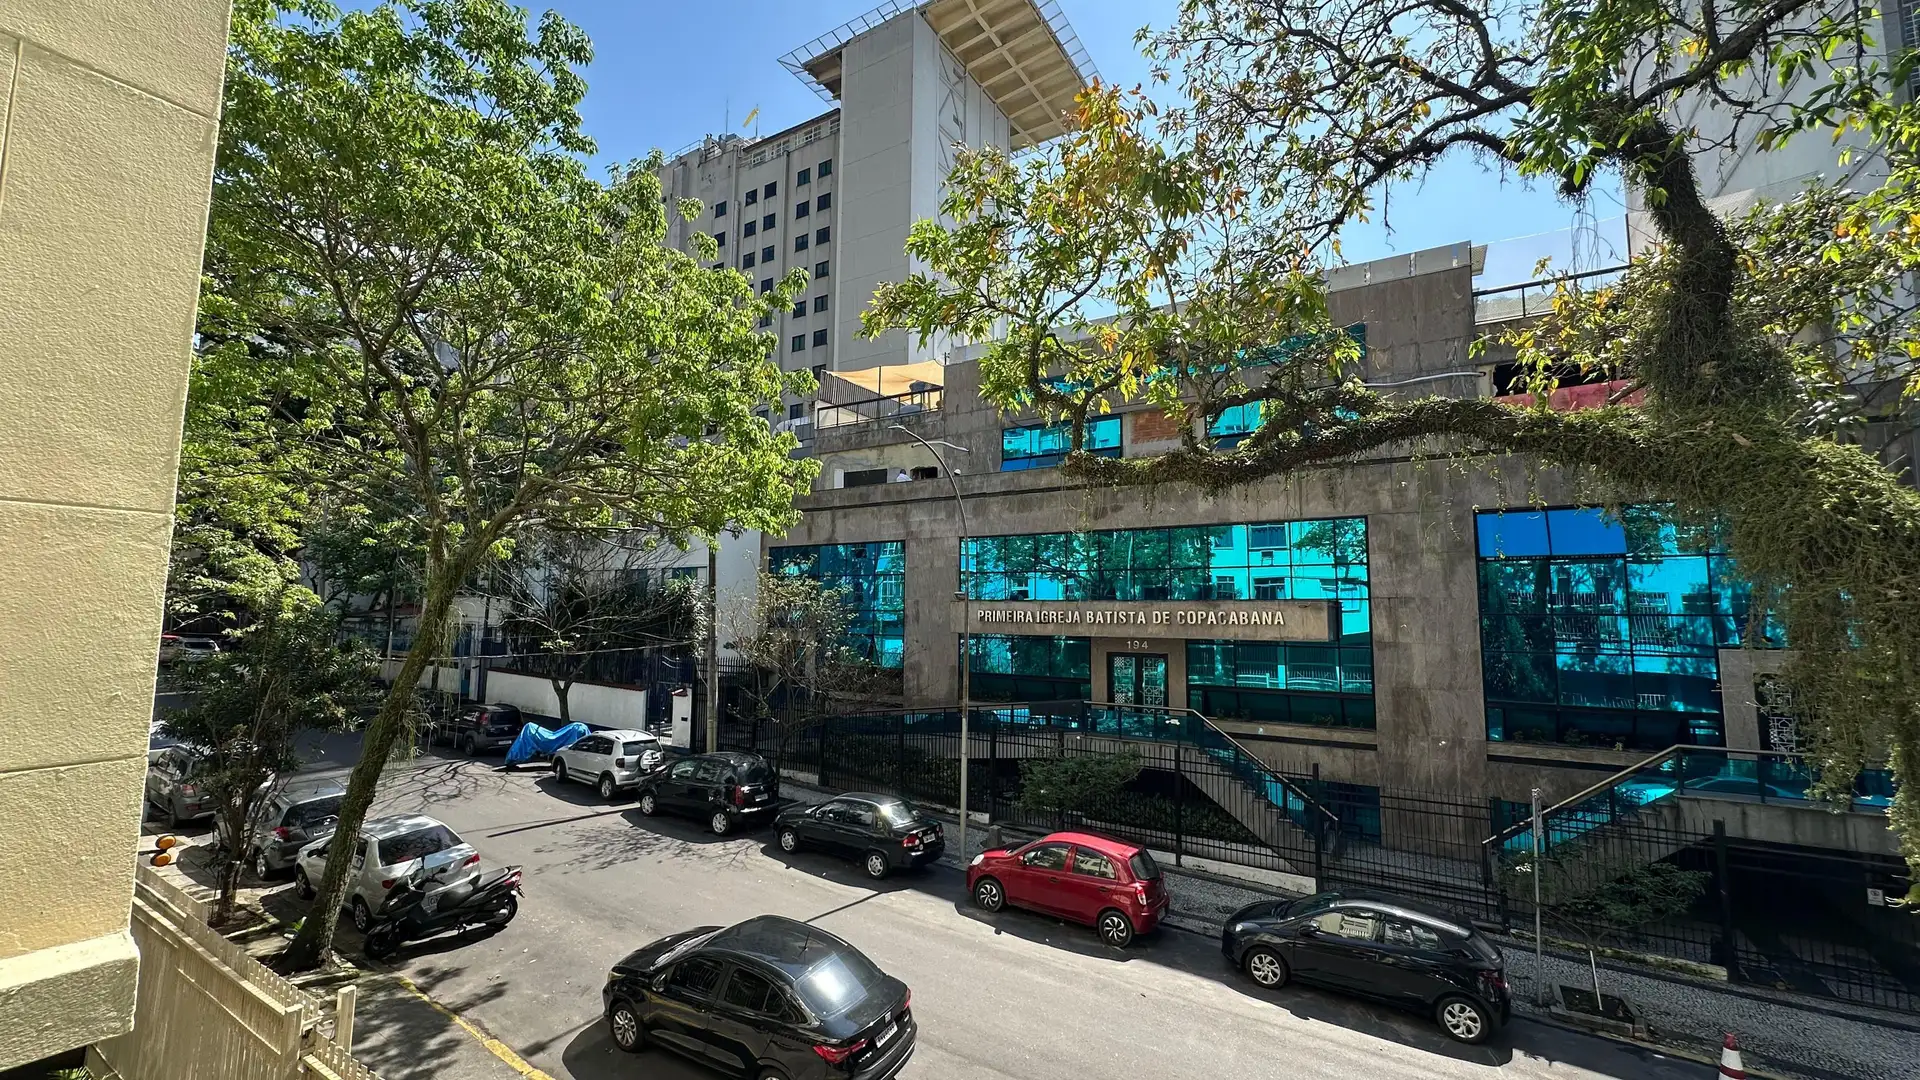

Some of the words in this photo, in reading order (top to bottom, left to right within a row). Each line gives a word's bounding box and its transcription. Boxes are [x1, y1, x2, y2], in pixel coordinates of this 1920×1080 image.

[977, 610, 1033, 623] PRIMEIRA
[1036, 611, 1081, 624] IGREJA
[1086, 611, 1146, 625] BATISTA
[1152, 611, 1171, 625] DE
[1177, 611, 1285, 625] COPACABANA
[1126, 640, 1149, 650] 194
